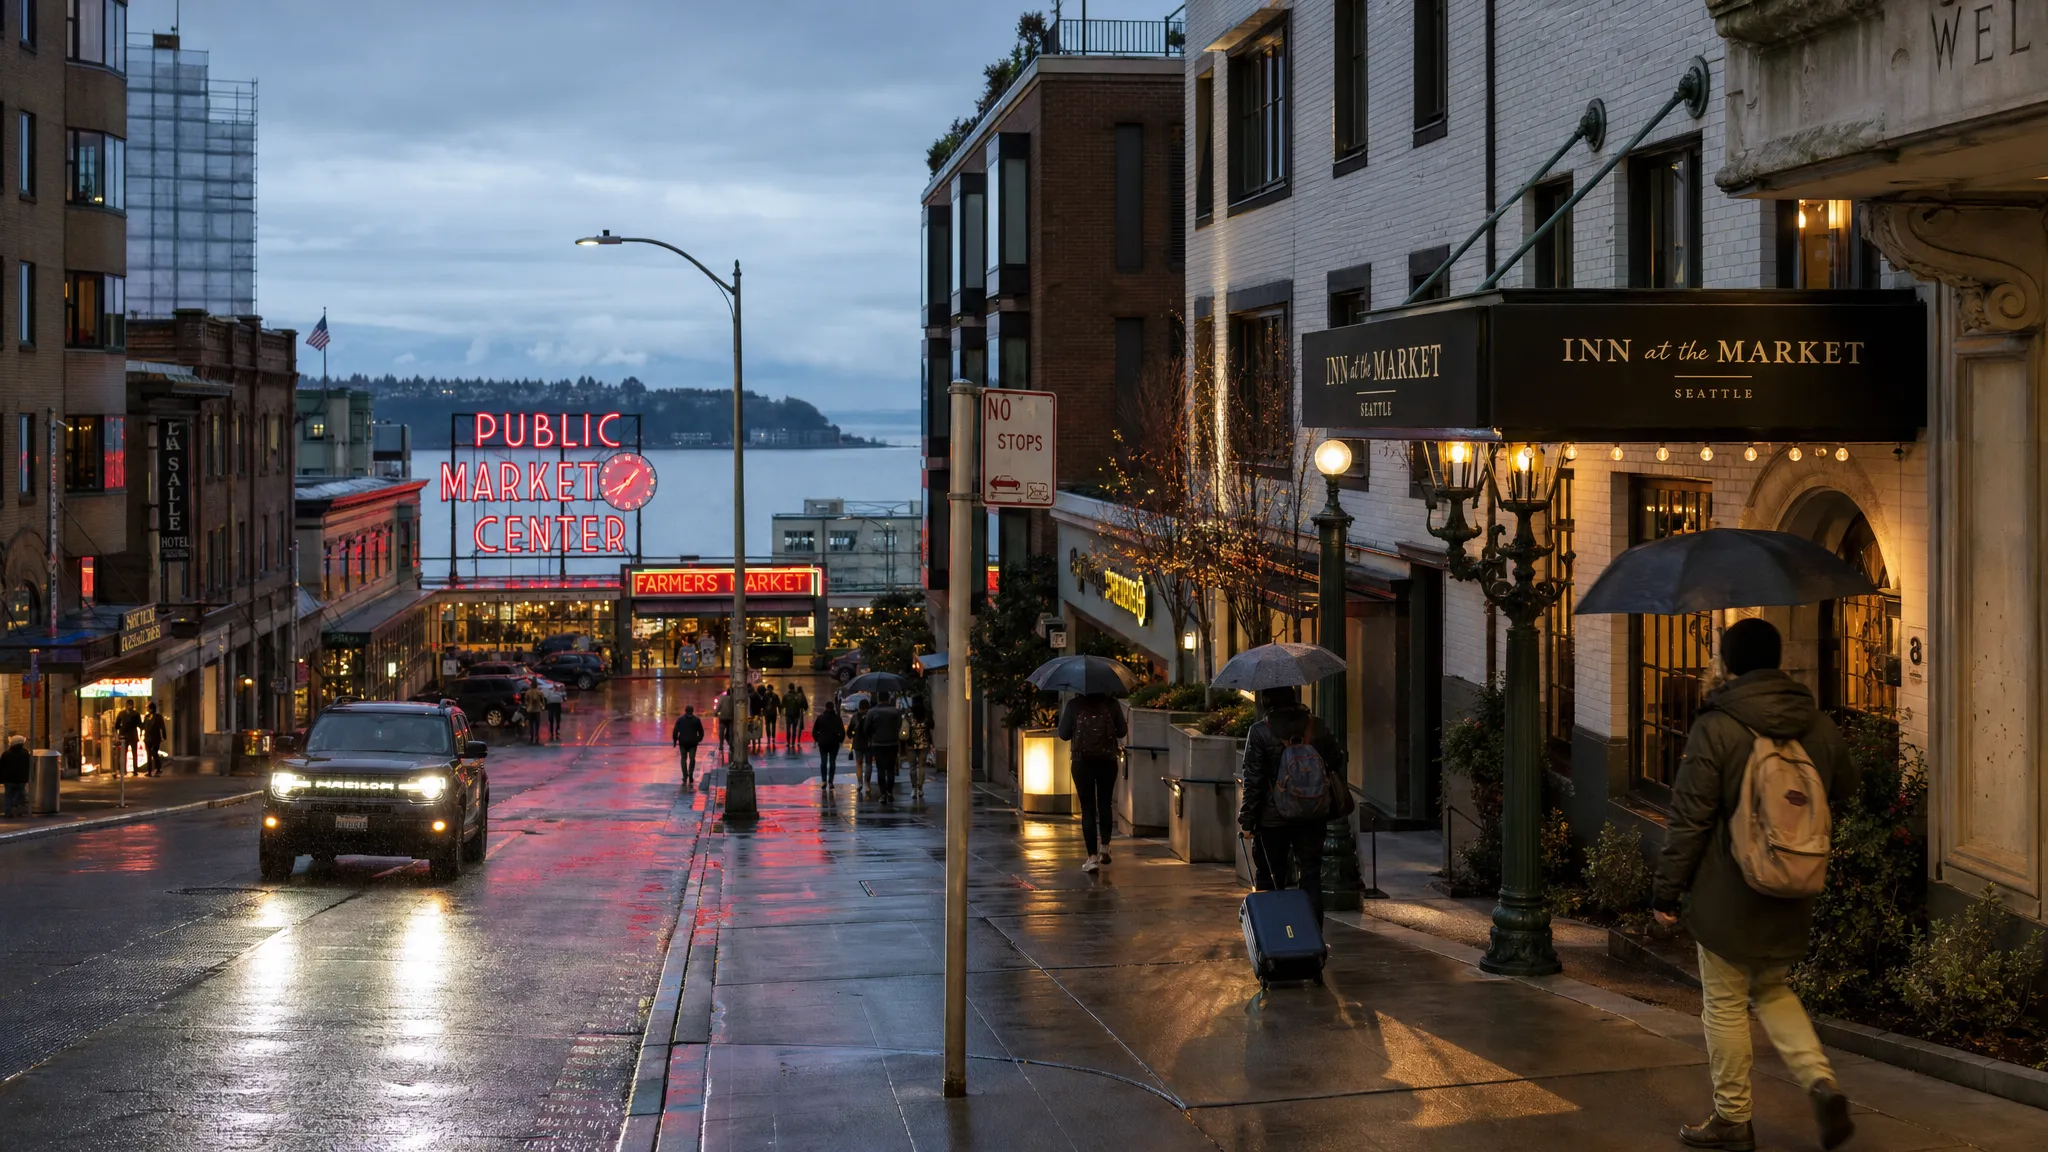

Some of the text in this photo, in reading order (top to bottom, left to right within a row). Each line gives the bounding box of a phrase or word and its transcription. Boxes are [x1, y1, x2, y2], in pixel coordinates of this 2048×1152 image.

[1562, 338, 1865, 364] INN at the MARKET
[1326, 343, 1442, 386] INN at the MARKET
[1674, 388, 1753, 399] SEATTLE
[988, 397, 1011, 421] NO
[1360, 401, 1392, 417] SEATTLE
[475, 412, 621, 448] PUBLIC
[997, 433, 1043, 452] STOPS
[165, 421, 181, 531] LA SALLE
[440, 461, 599, 502] MARKET
[161, 536, 190, 548] HOTEL
[473, 515, 626, 553] CENTER
[636, 574, 718, 593] FARMERS
